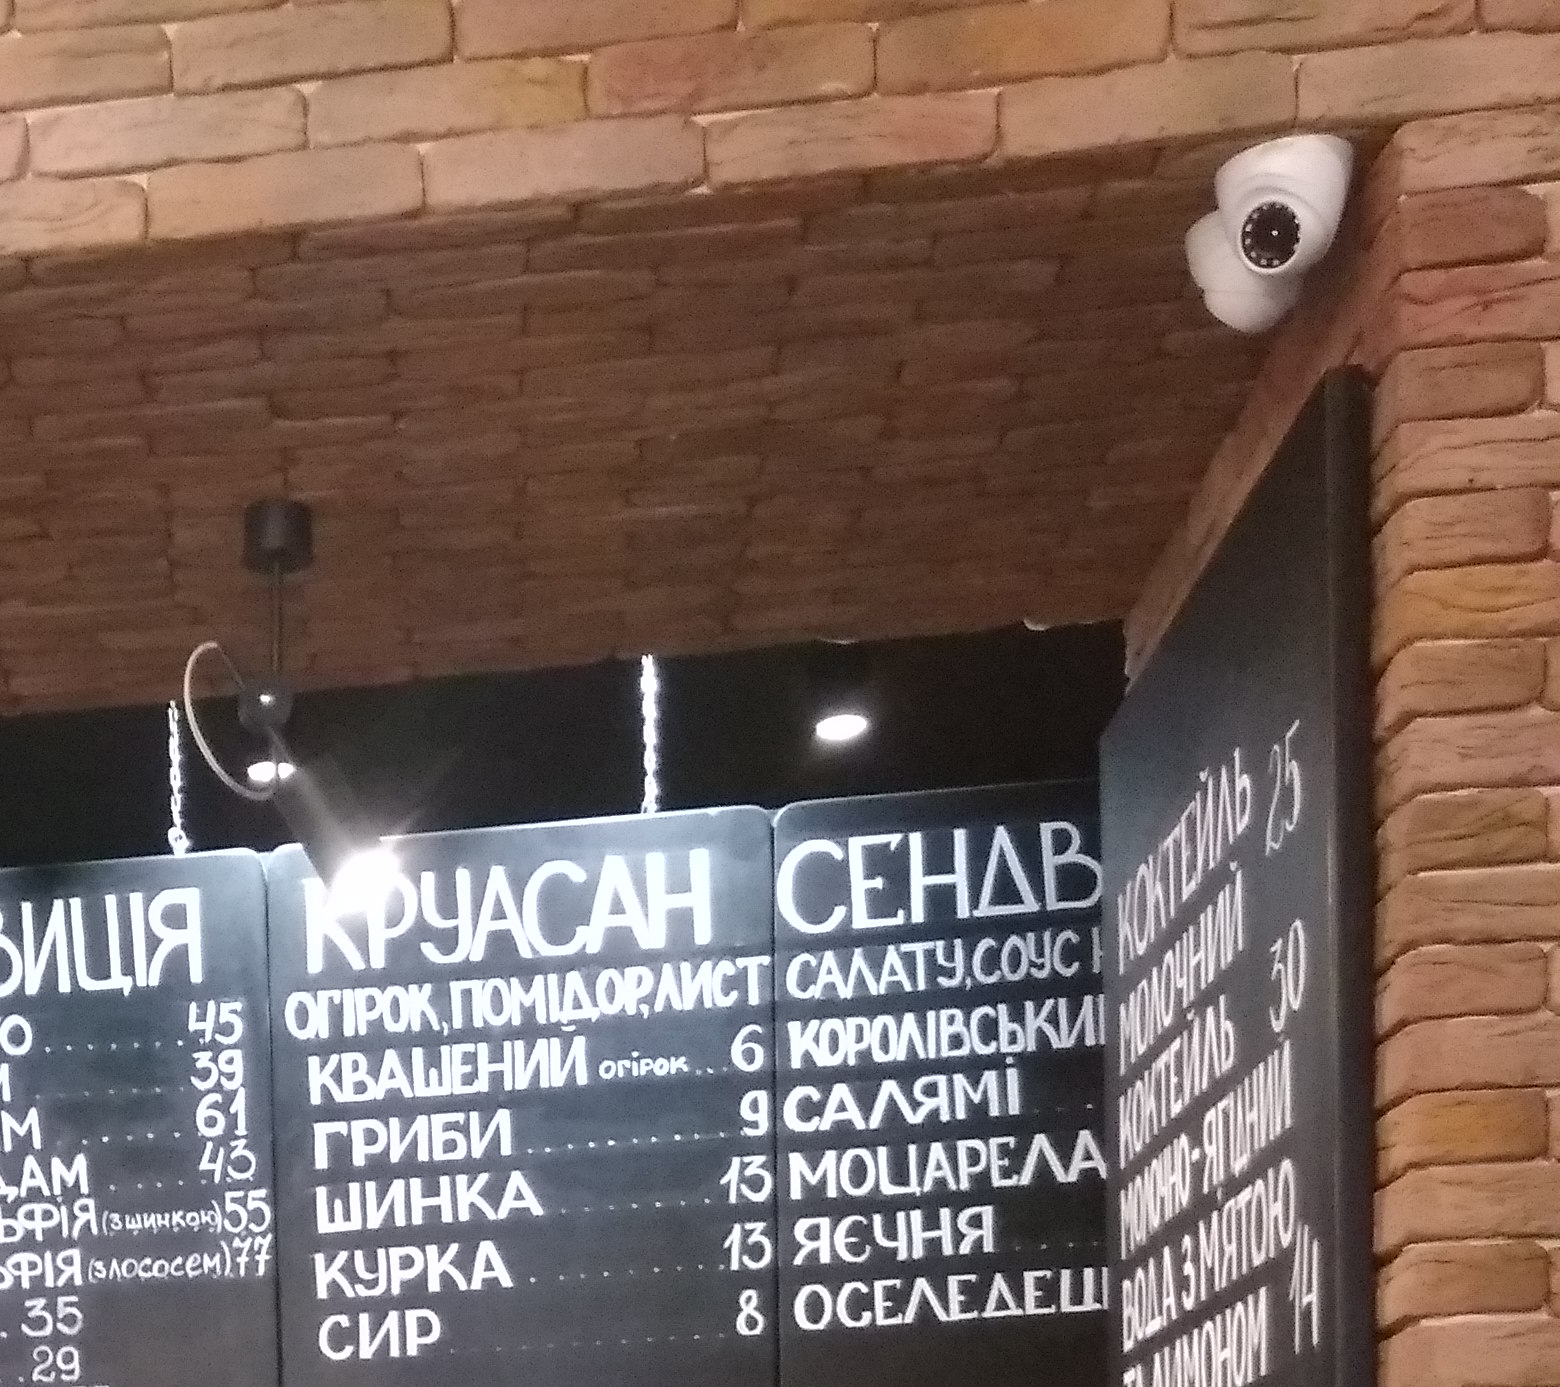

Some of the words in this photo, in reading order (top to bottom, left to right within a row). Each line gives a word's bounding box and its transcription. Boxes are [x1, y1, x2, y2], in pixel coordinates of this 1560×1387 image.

[1117, 747, 1251, 975] КОКТЕЙЛЬ
[1266, 719, 1302, 856] 25
[303, 848, 711, 974] КРУАСАН
[1118, 861, 1244, 1077] МОЛОЧНИЙ
[188, 1001, 243, 1045] 45
[1119, 993, 1236, 1170] КОКТЕЙЛЬ
[1268, 918, 1307, 1033] 30
[190, 1050, 243, 1091] 39
[308, 1024, 588, 1106] КВАШЕНИЙ
[730, 1024, 765, 1072] 6
[783, 1056, 1021, 1132] САЛЯМІ
[196, 1094, 248, 1139] 61
[313, 1108, 513, 1171] ГРИБИ
[740, 1089, 769, 1137] 9
[199, 1141, 255, 1180] 43
[316, 1170, 543, 1233] ШИНКА
[721, 1155, 772, 1204] 13
[789, 1130, 1107, 1199] МОЦАРЕЛА
[224, 1189, 271, 1233] 55
[793, 1205, 996, 1265] ЯЄЧНЯ
[232, 1233, 272, 1277] 77
[314, 1240, 514, 1300] КУРКА
[723, 1222, 773, 1271] 13
[1288, 1223, 1320, 1354] 14
[21, 1296, 83, 1338] 35
[319, 1309, 442, 1361] СИР
[736, 1288, 764, 1335] 8
[1122, 1244, 1176, 1353] ВОДА
[32, 1346, 81, 1382] 29
